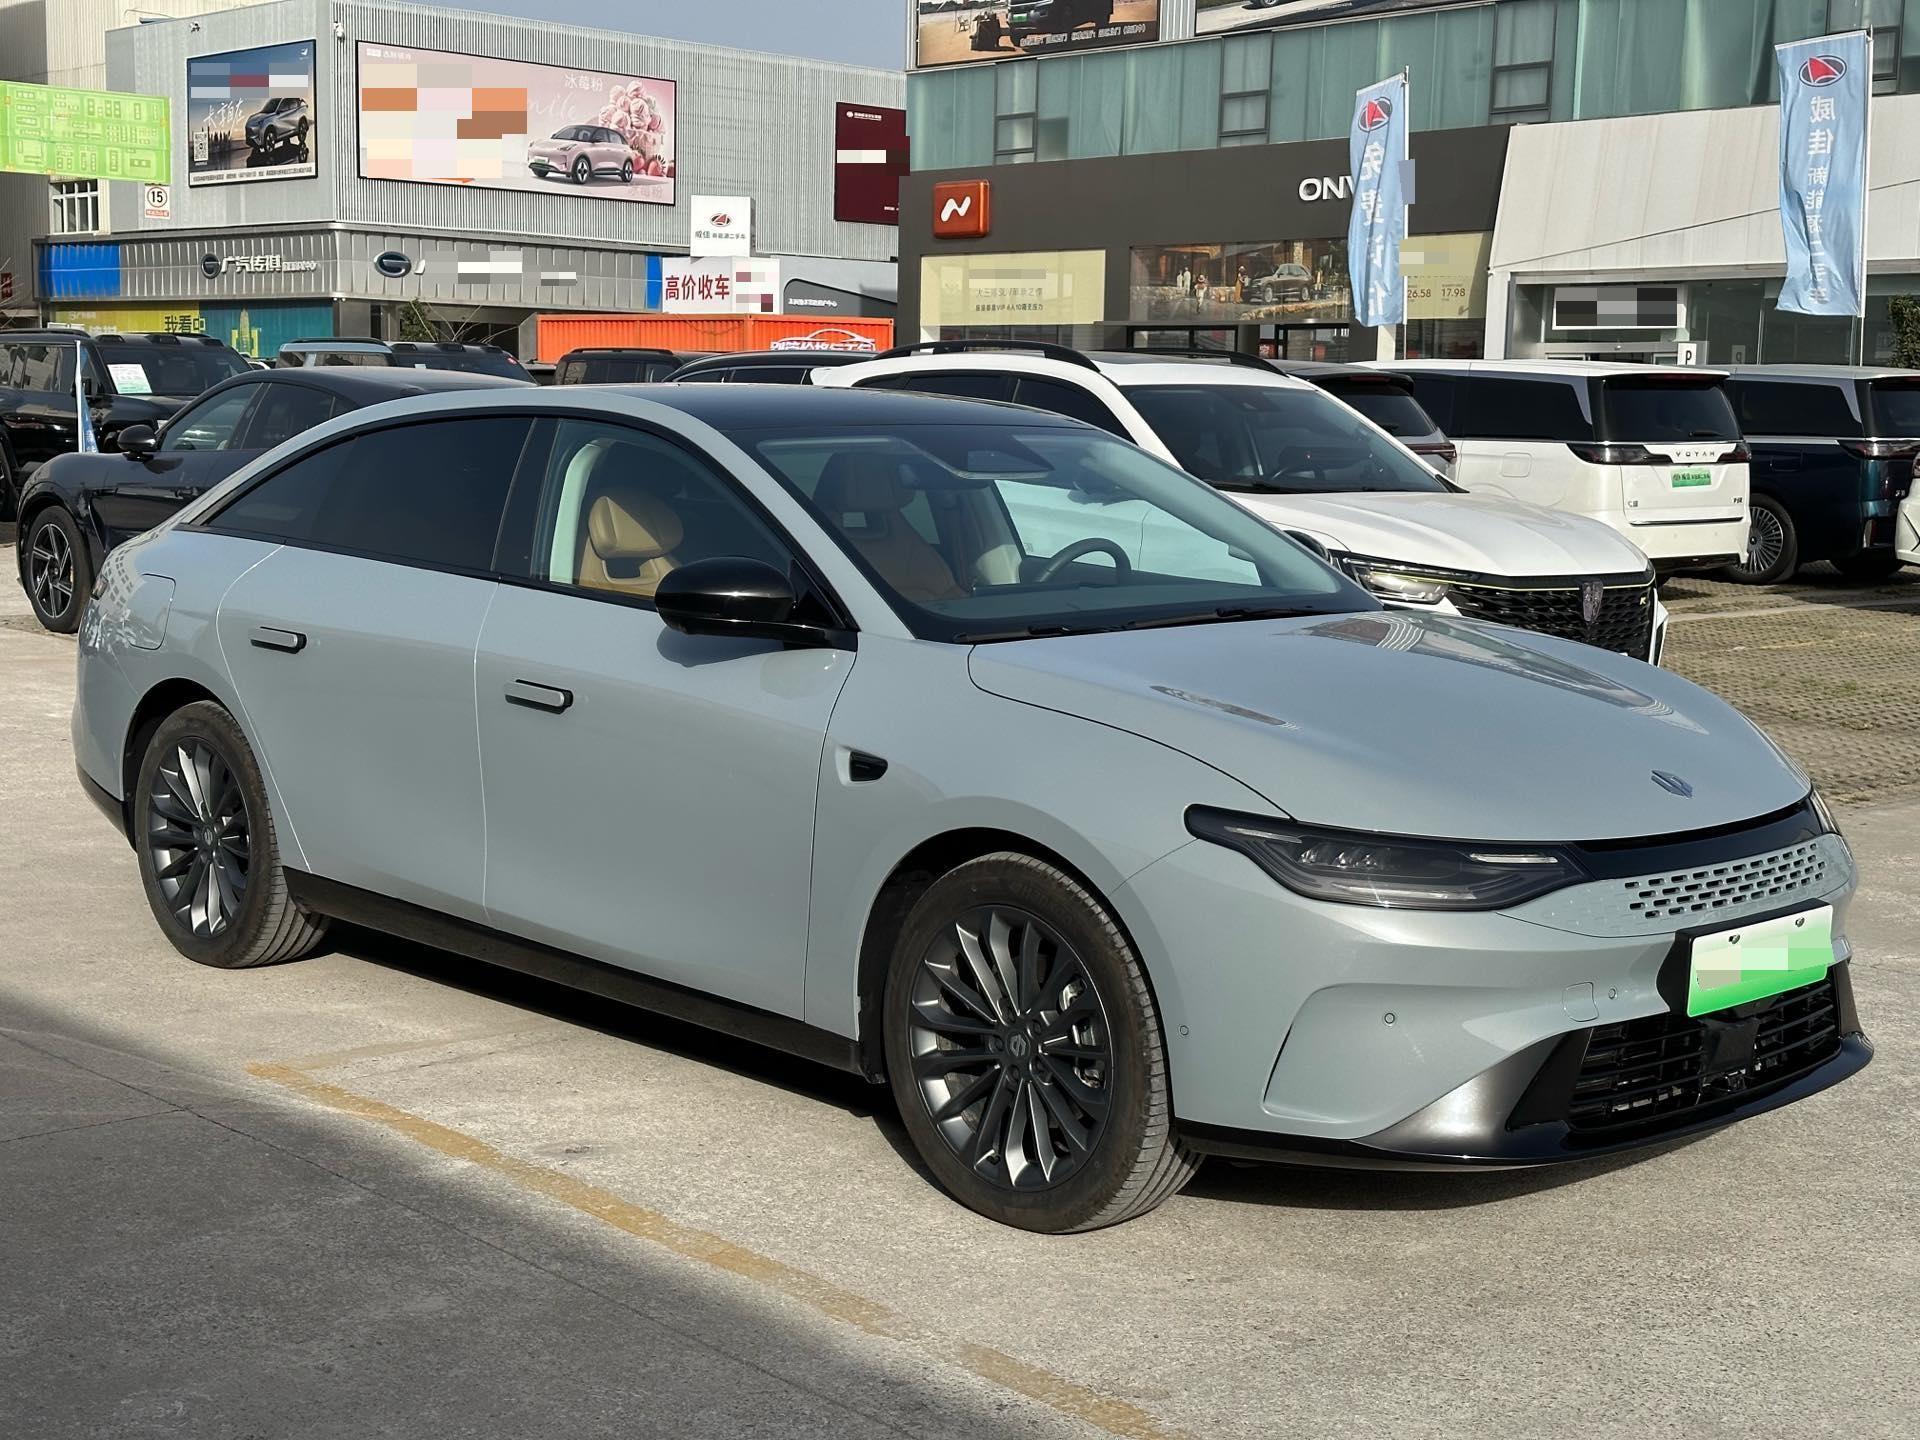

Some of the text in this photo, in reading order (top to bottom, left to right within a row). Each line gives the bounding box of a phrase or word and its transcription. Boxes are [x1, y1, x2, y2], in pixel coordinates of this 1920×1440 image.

[564, 74, 603, 92] 冰莓粉
[151, 190, 163, 203] 15
[221, 254, 281, 274] 广汽传祺
[665, 274, 730, 301] 高价收车
[1441, 288, 1466, 297] 17.98
[1685, 348, 1693, 365] P
